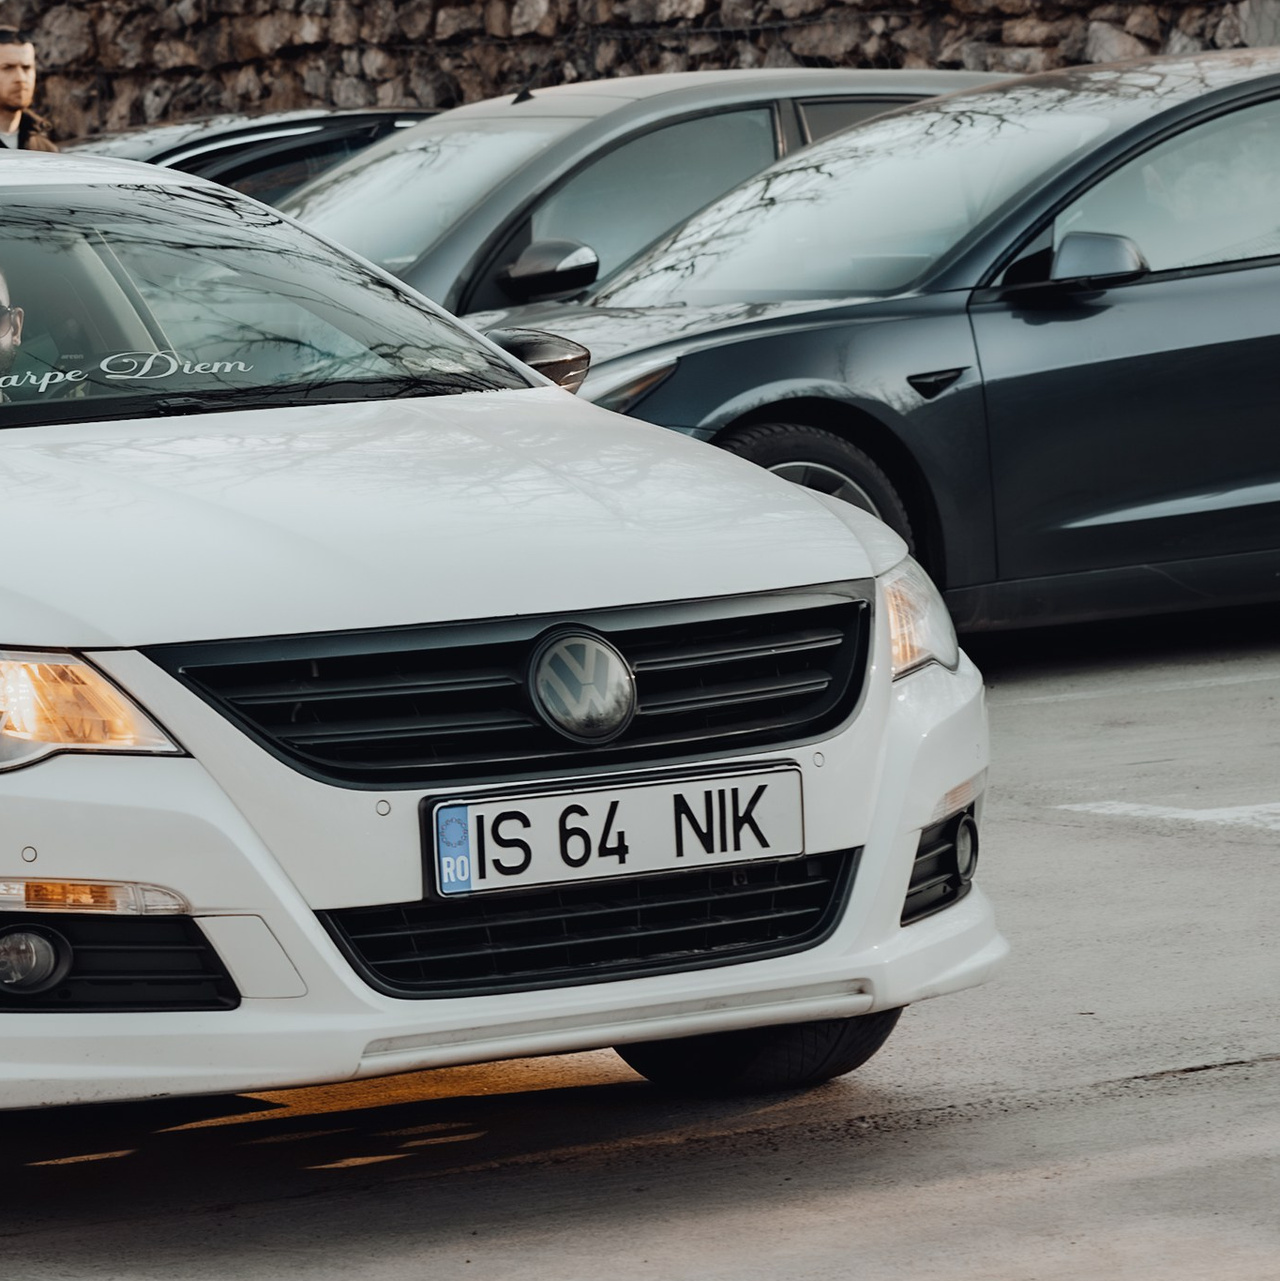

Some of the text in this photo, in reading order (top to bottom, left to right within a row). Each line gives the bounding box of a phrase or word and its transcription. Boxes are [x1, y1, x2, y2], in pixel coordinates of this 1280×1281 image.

[99, 349, 254, 380] Diem
[475, 784, 771, 880] IS 64 NIK
[441, 855, 470, 884] RO
